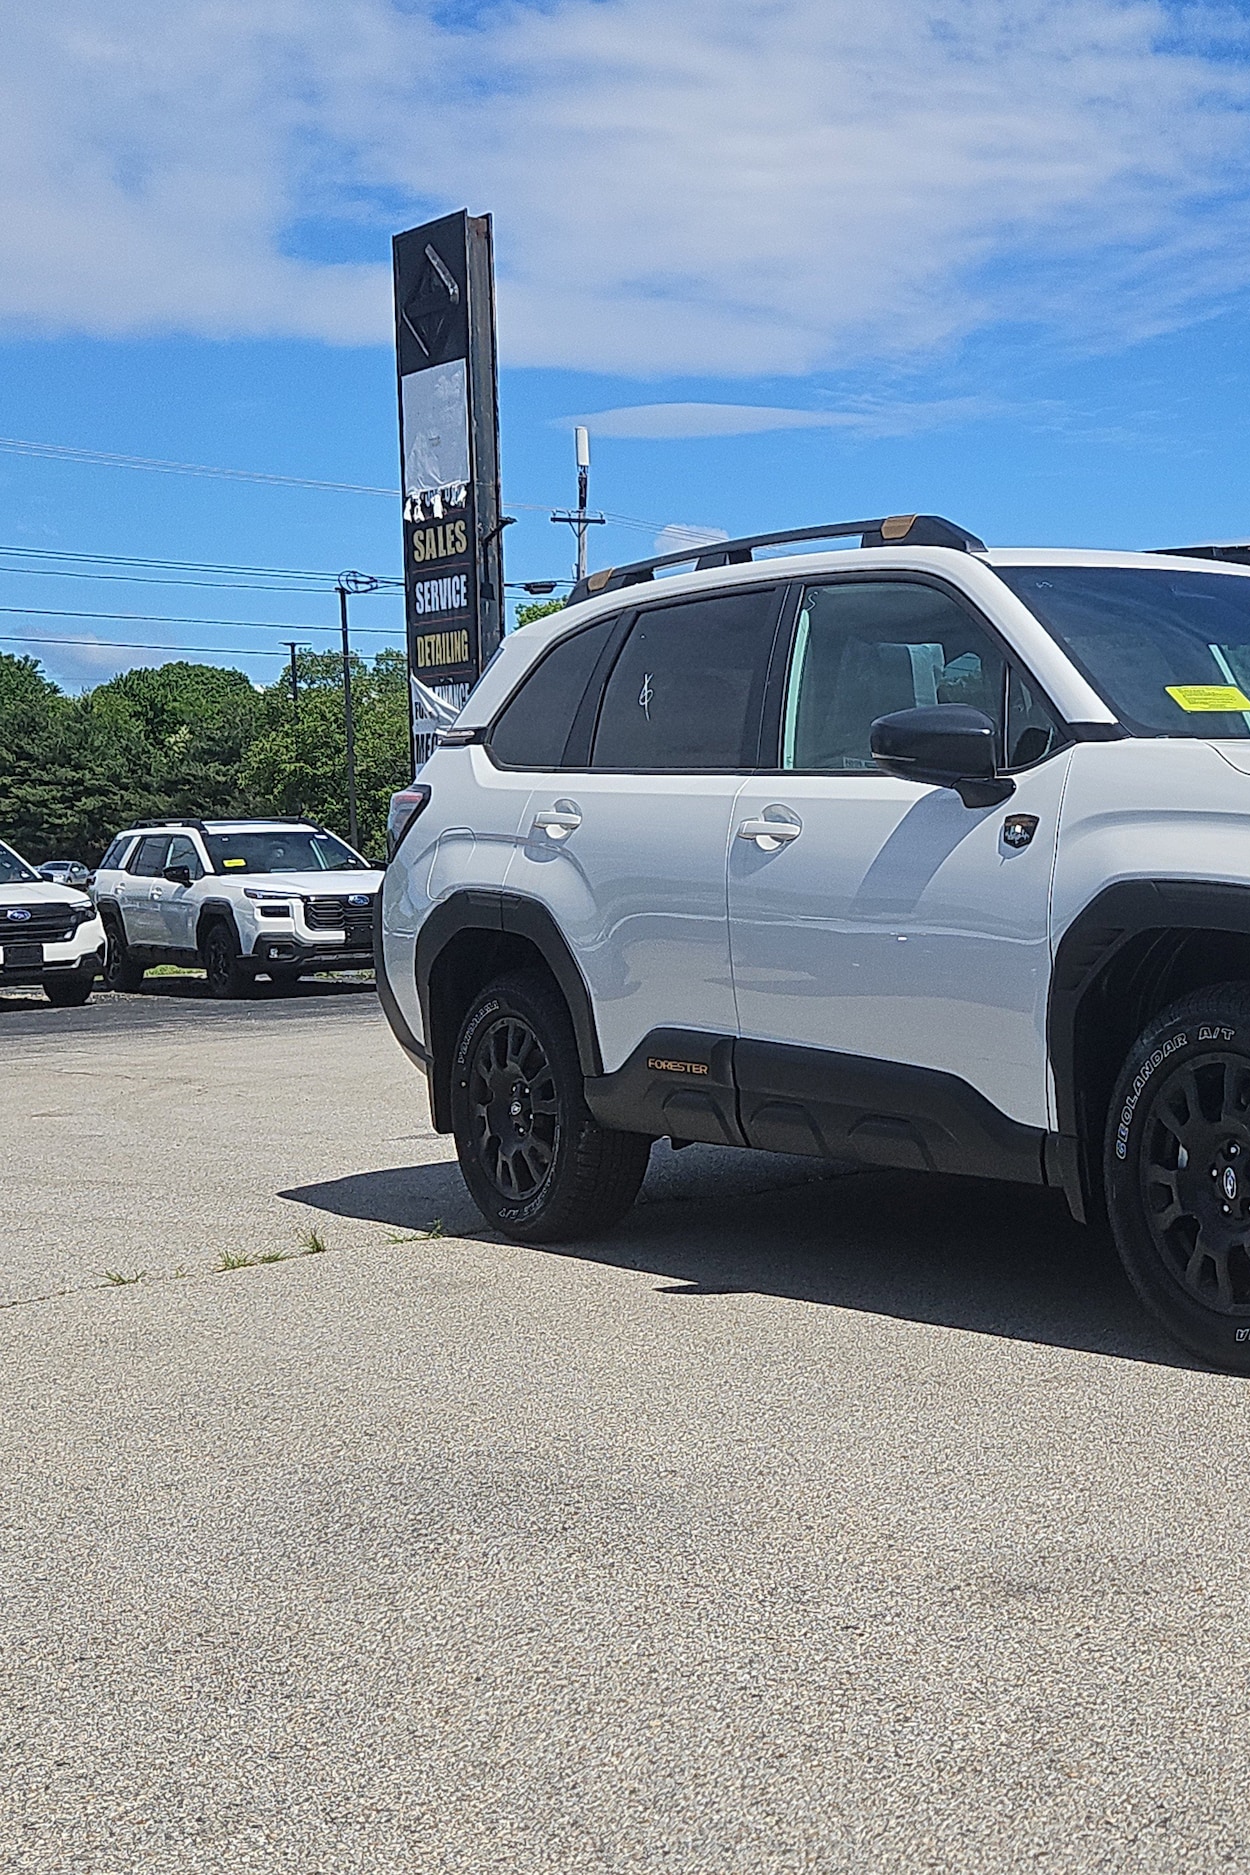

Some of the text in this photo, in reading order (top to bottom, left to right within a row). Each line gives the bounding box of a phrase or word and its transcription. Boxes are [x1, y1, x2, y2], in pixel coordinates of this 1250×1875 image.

[413, 519, 468, 563] SALES
[415, 574, 468, 615] SERVICE
[416, 629, 469, 668] DETAILING
[648, 1058, 708, 1075] FORESTER
[1115, 1026, 1236, 1160] GEOLANDAR A/T
